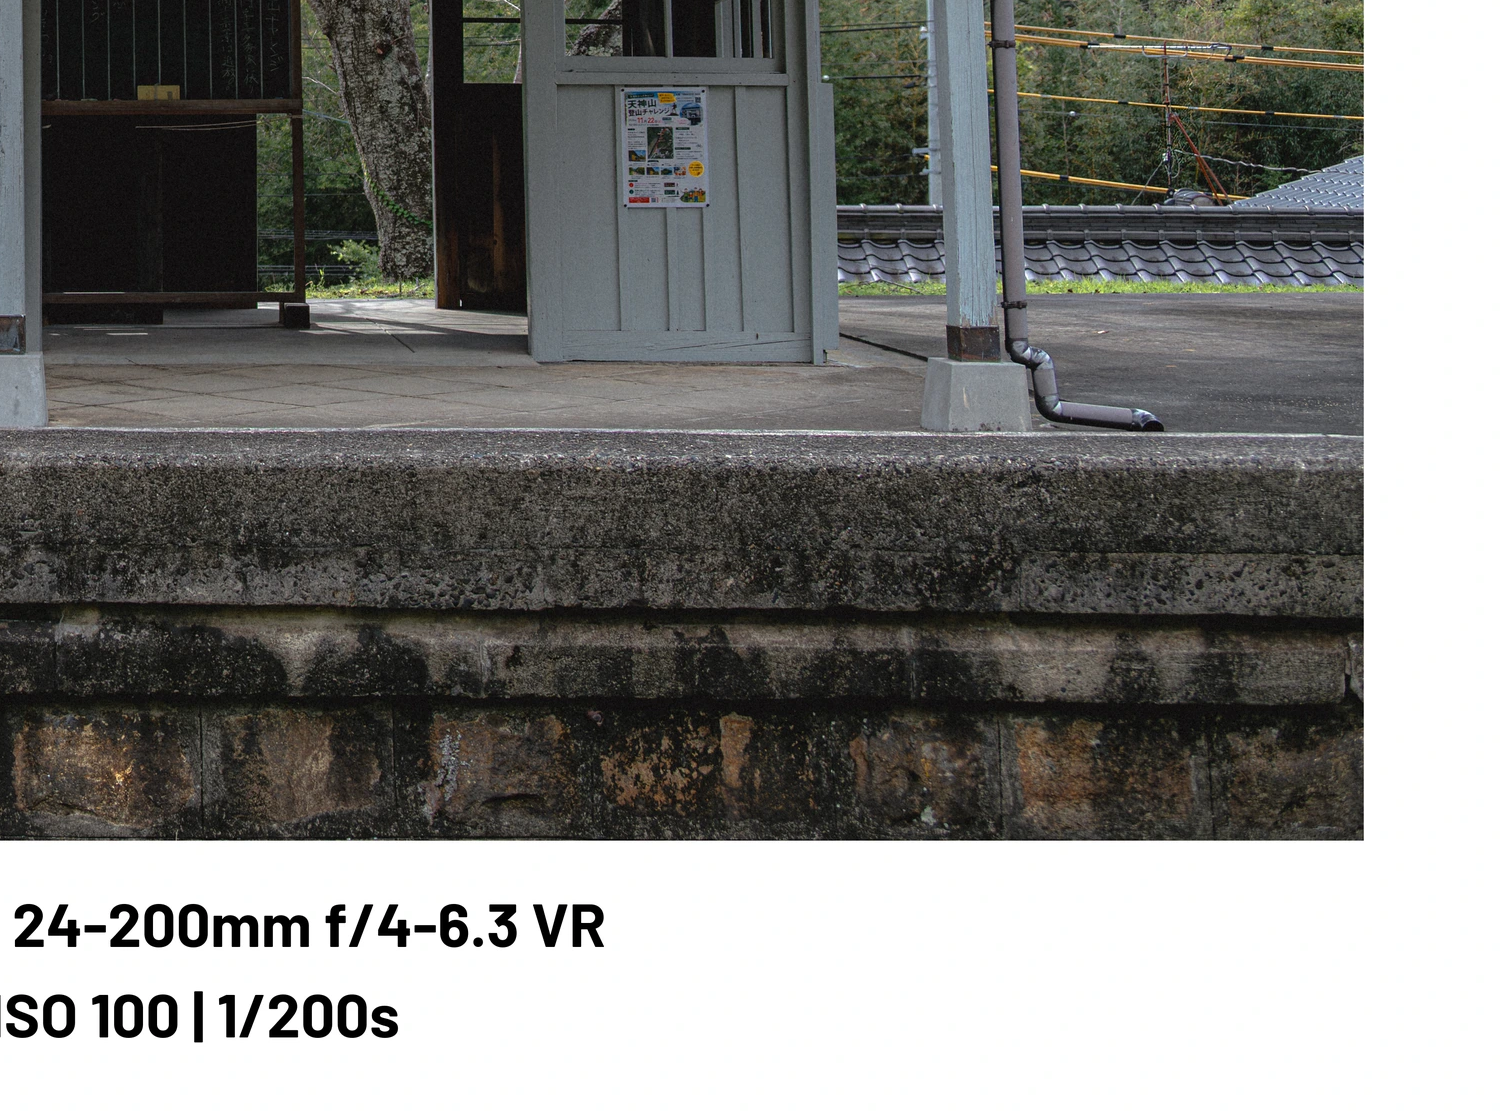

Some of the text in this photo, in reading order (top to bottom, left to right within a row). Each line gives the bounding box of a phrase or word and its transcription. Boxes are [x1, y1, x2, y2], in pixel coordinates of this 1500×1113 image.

[628, 99, 657, 109] 天神山
[628, 108, 670, 116] 登山チャレンジ
